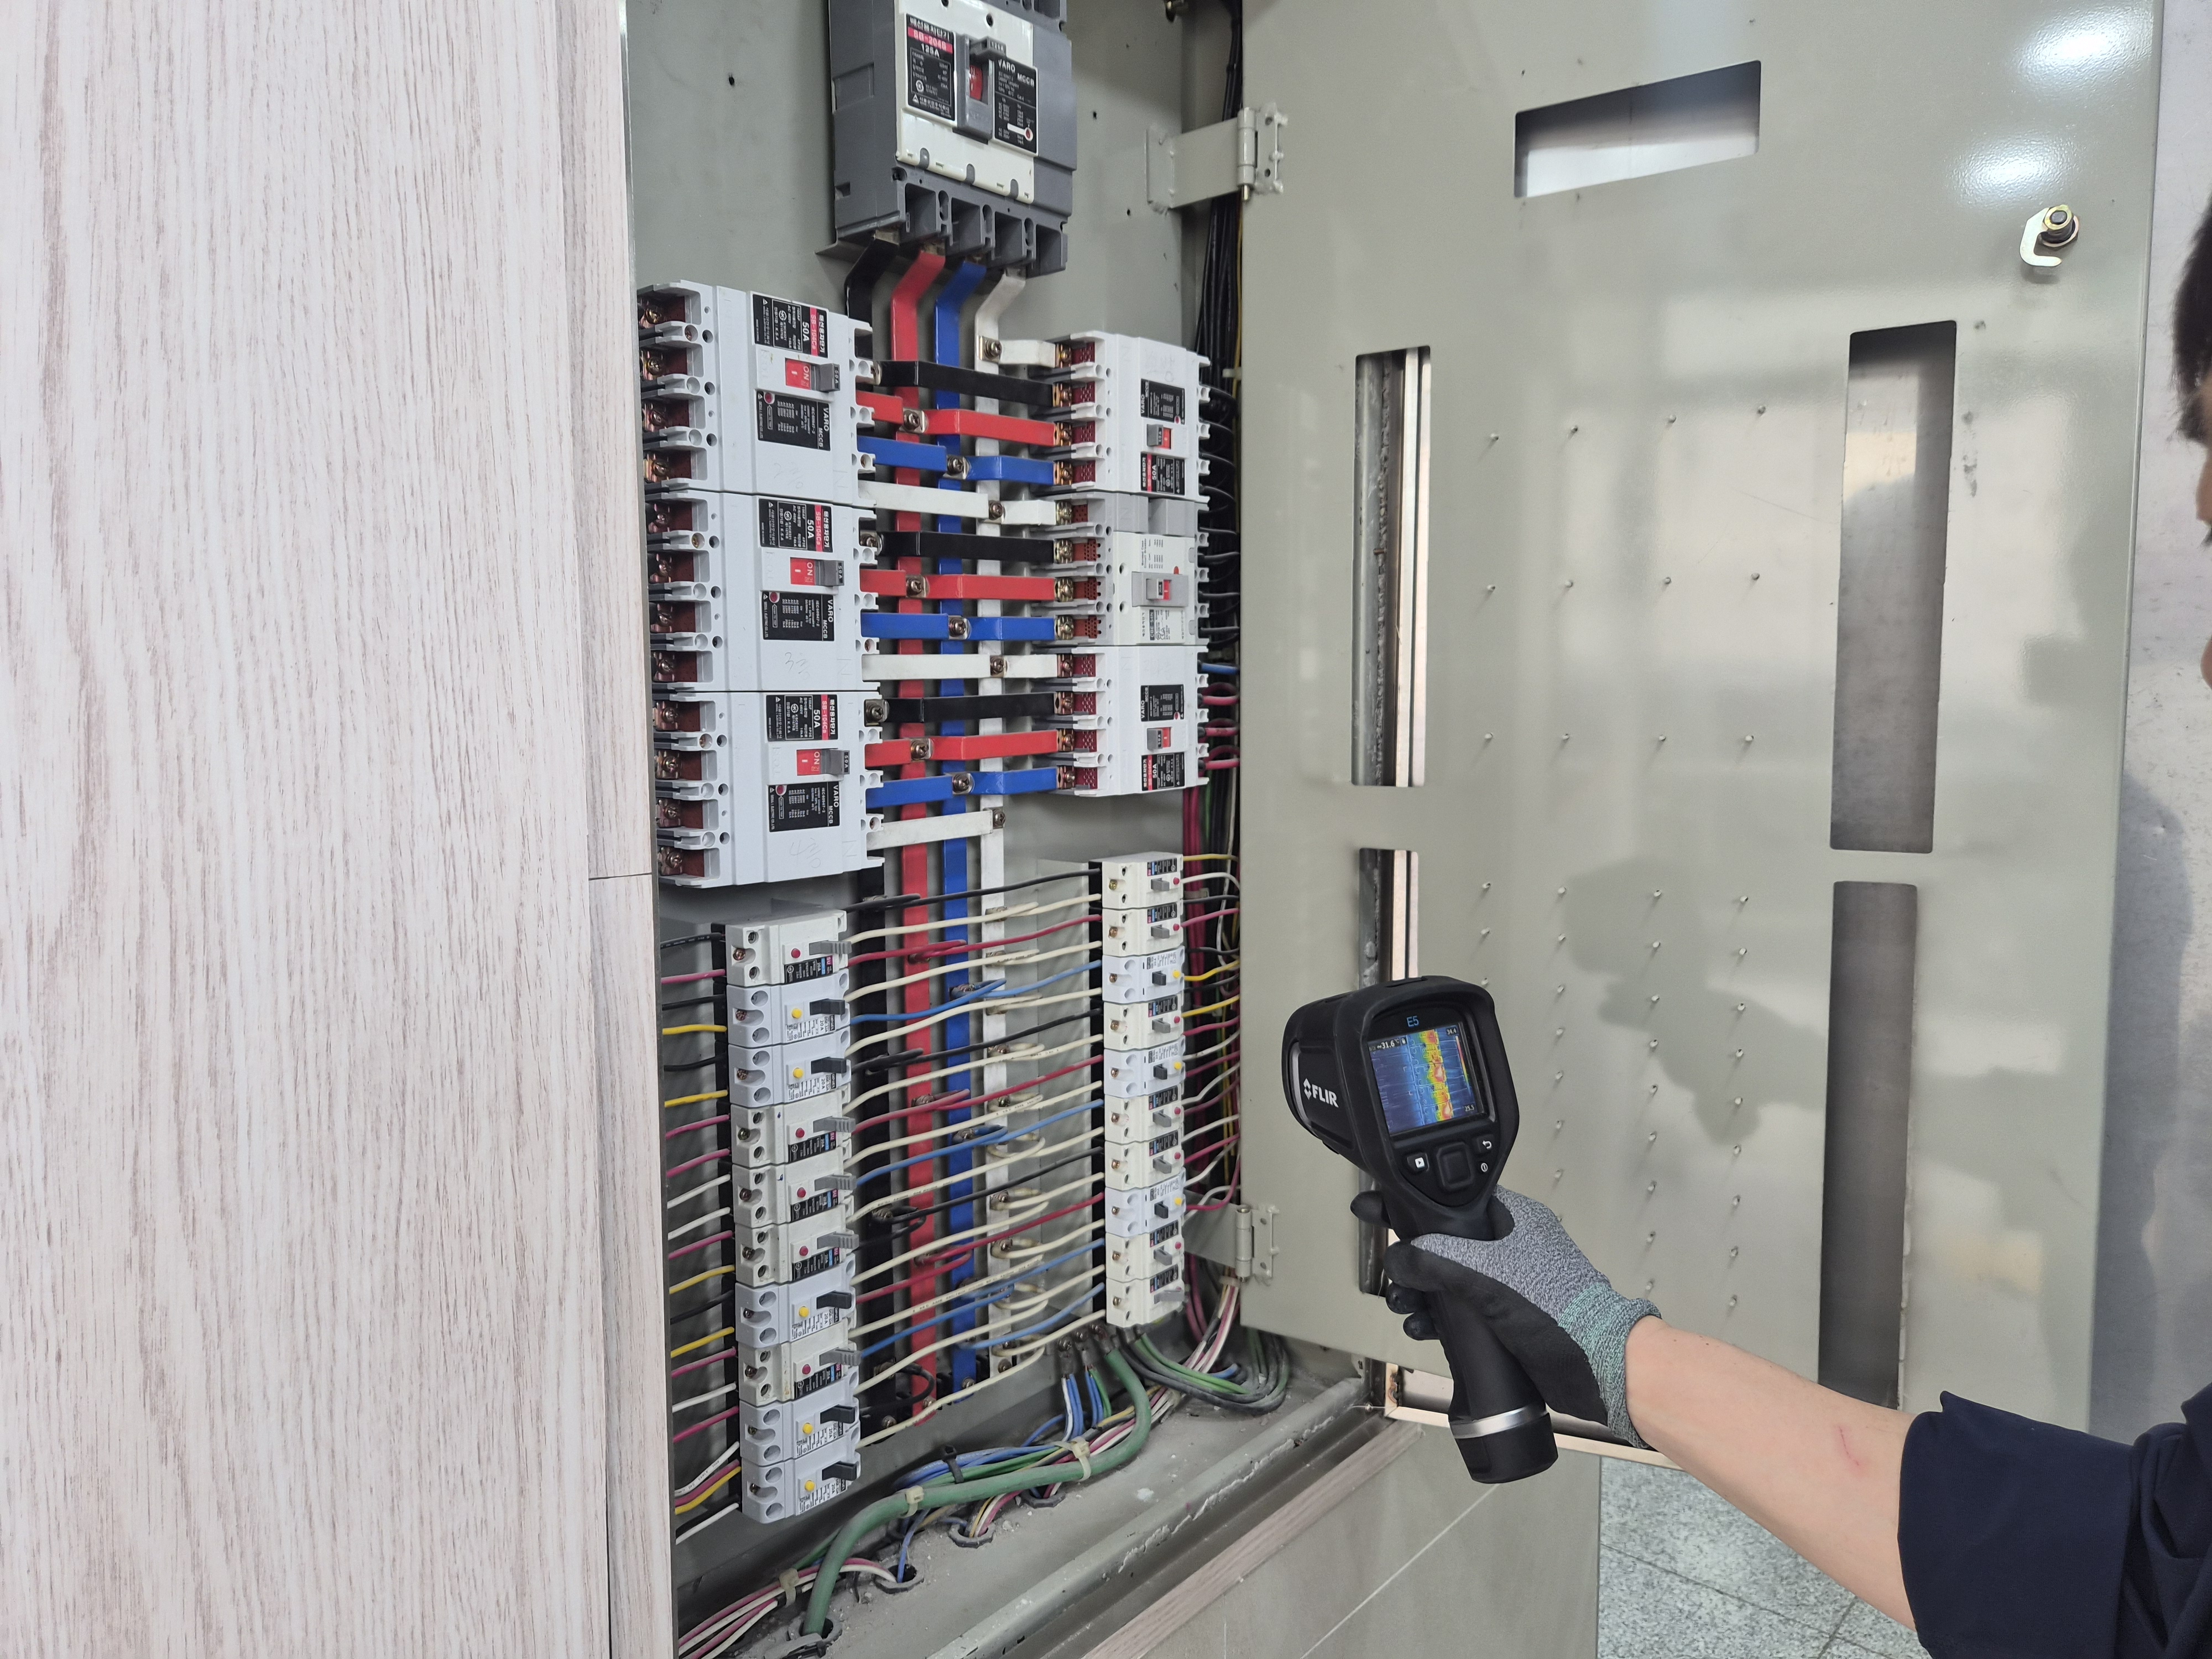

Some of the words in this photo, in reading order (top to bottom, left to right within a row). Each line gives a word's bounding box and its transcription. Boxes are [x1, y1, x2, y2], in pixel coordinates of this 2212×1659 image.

[998, 59, 1015, 73] VARO
[804, 366, 809, 380] ON
[807, 562, 812, 576] ON
[814, 752, 820, 764] ON
[1406, 1015, 1420, 1027] E5
[1312, 1089, 1339, 1108] FLIR
